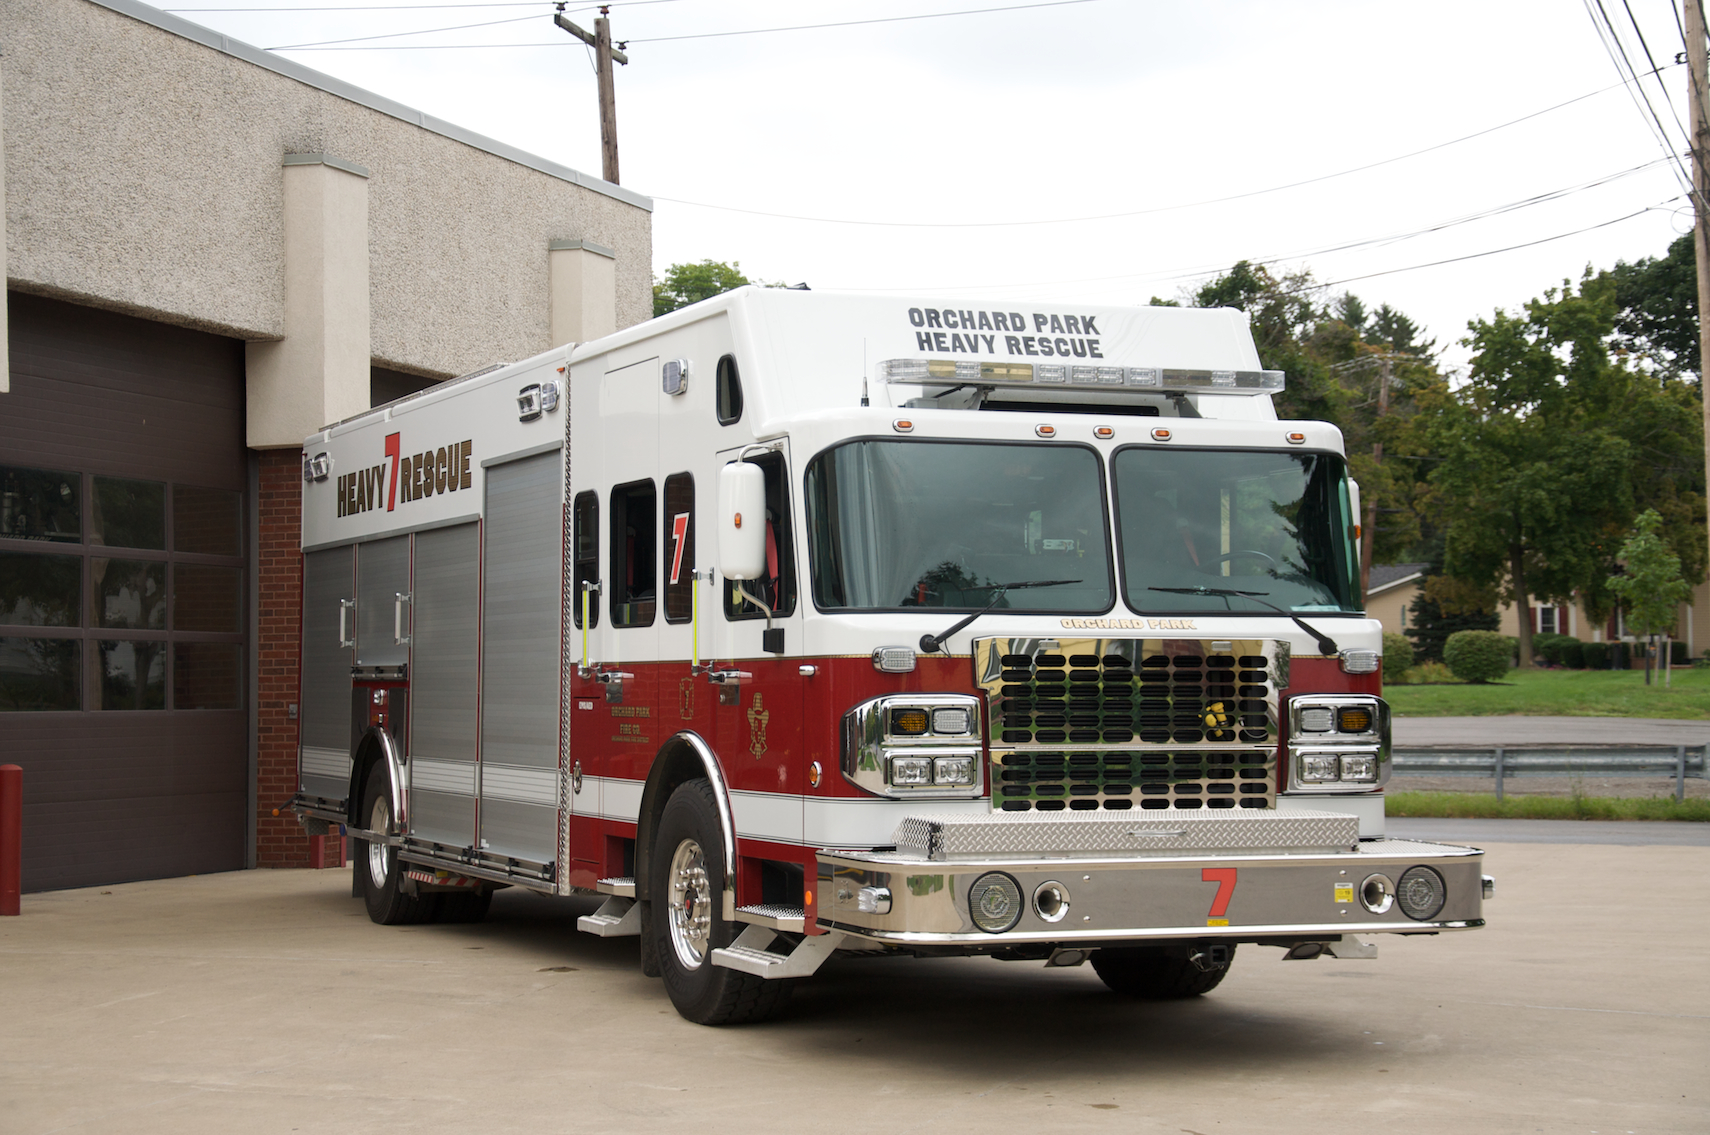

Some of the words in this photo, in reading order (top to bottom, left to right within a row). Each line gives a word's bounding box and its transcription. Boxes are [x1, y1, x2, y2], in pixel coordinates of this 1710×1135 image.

[908, 307, 1027, 332] ORCHARD
[1032, 313, 1101, 335] PARK
[915, 331, 996, 354] HEAVY
[1004, 335, 1104, 359] RESCUE
[337, 463, 386, 518] HEAVY
[384, 431, 400, 512] 7
[400, 439, 472, 503] RESCUE
[669, 511, 690, 585] 7
[1060, 618, 1145, 630] ORCHARD
[1147, 619, 1197, 630] PARK
[611, 706, 635, 717] ORCHARD
[635, 706, 650, 718] PARK
[620, 723, 632, 735] FIRE
[1201, 867, 1237, 917] 7
